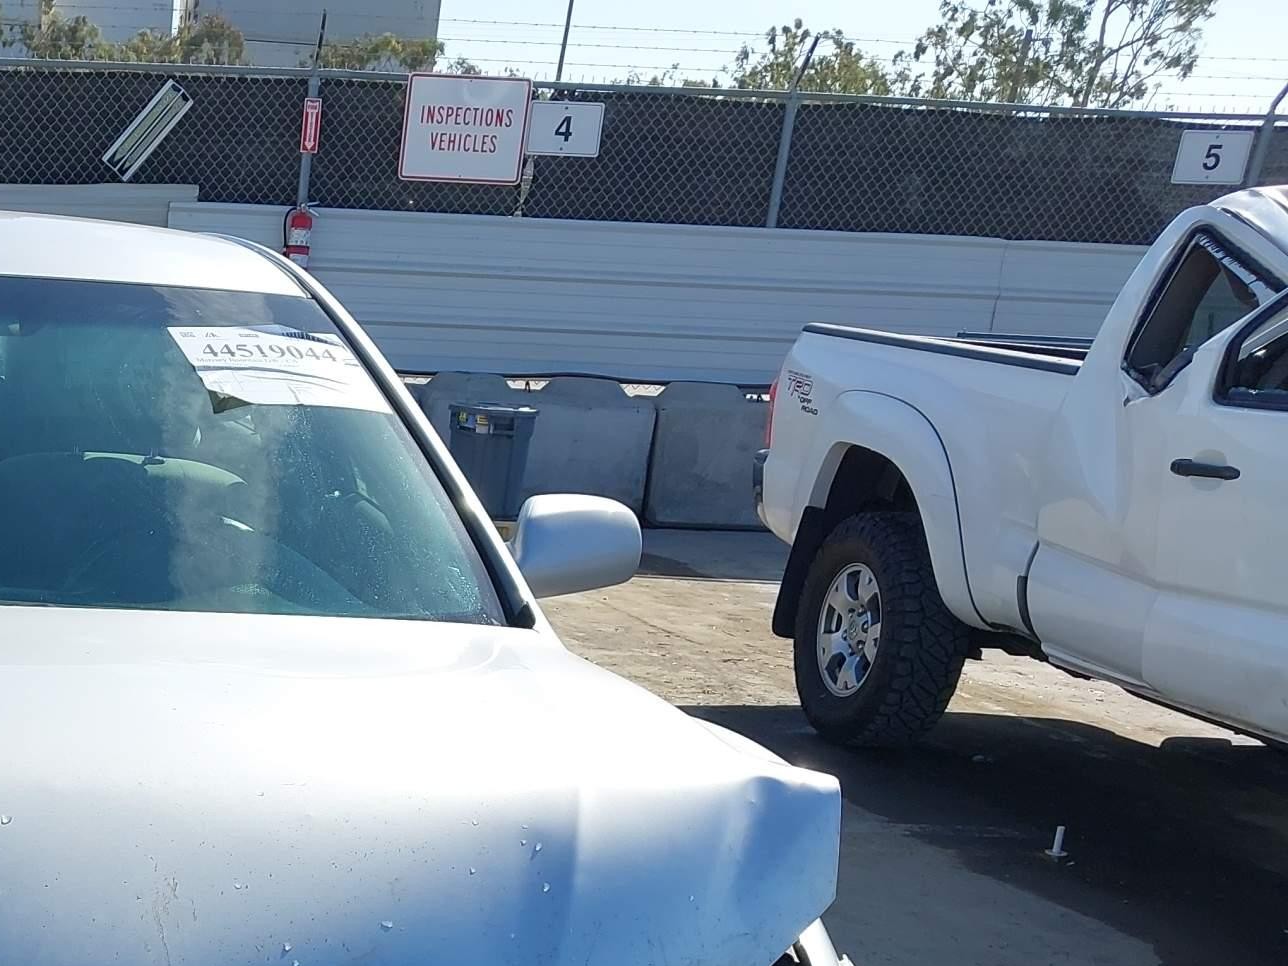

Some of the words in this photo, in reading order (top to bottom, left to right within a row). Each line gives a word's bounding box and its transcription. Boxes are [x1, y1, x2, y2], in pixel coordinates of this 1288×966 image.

[420, 105, 513, 128] INSPECTIONS
[554, 115, 573, 142] 4
[430, 133, 497, 153] VEHICLES
[1202, 144, 1223, 171] 5
[202, 342, 337, 362] 44519044
[787, 374, 813, 397] TRD
[801, 405, 818, 415] ROAD
